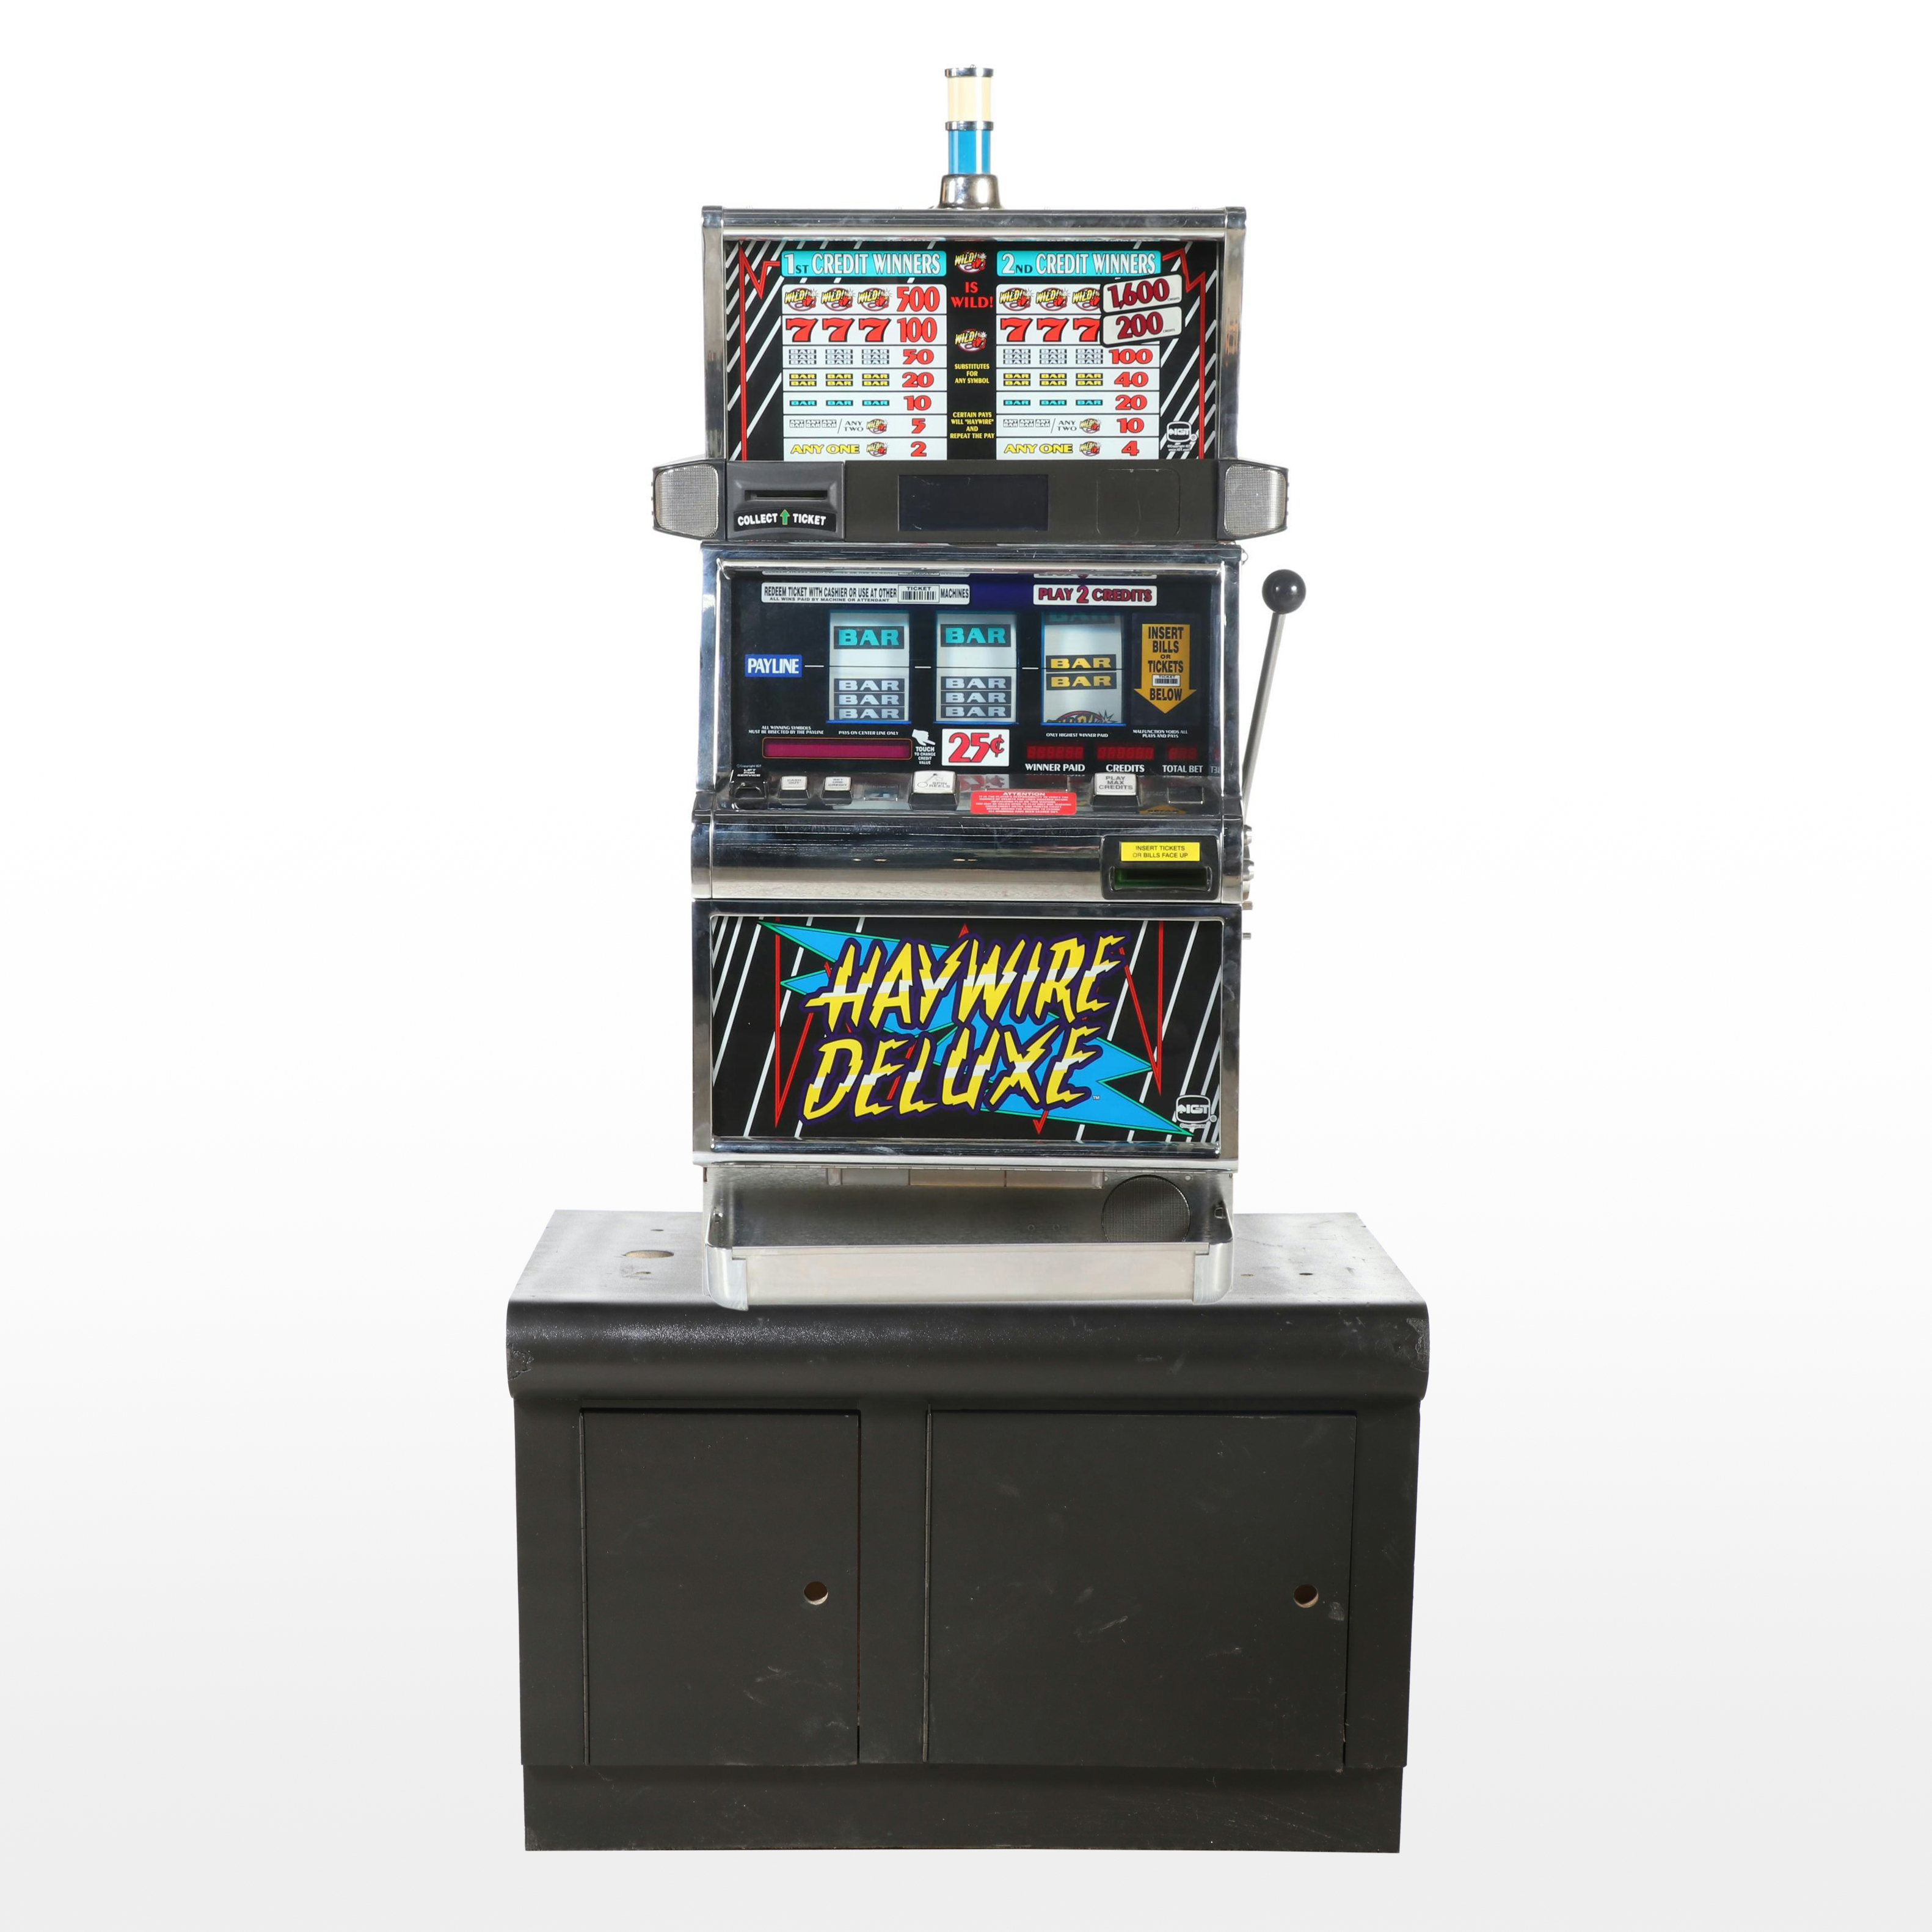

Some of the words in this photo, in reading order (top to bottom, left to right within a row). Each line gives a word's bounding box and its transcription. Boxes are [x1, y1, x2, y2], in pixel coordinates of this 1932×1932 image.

[784, 253, 809, 274] 1ST
[812, 253, 869, 274] CREDIT
[873, 253, 941, 274] WINNERS
[955, 252, 977, 266] WILD!
[1002, 253, 1033, 274] 2ND
[1036, 253, 1088, 274] CREDIT
[1093, 253, 1156, 274] WINNERS
[965, 282, 978, 293] IS
[999, 289, 1024, 303] WILD!
[1036, 289, 1060, 303] WILD!
[1107, 278, 1170, 308] 1,600
[785, 289, 809, 303] WILD!
[822, 289, 846, 303] WILD!
[858, 289, 883, 303] WILD!
[897, 286, 940, 312] 500
[950, 296, 994, 308] WILD!
[786, 318, 818, 342] 7
[822, 318, 855, 342] 7
[858, 318, 891, 342] 7
[897, 317, 938, 342] 100
[1000, 318, 1033, 342] 7
[1037, 318, 1070, 342] 7
[1073, 318, 1100, 342] 7
[1116, 312, 1164, 340] 200
[955, 331, 977, 344] WILD!
[903, 349, 935, 365] 50
[1109, 348, 1153, 364] 100
[902, 372, 934, 387] 20
[1114, 371, 1148, 387] 40
[903, 395, 931, 410] 10
[1115, 395, 1147, 410] 20
[911, 418, 926, 434] 5
[1117, 418, 1145, 433] 10
[790, 445, 823, 454] ANY
[826, 445, 860, 454] ONE
[911, 441, 927, 456] 2
[1004, 444, 1037, 453] ANY
[1040, 444, 1073, 453] ONE
[1121, 440, 1139, 456] 4
[737, 513, 778, 526] COLLECT
[793, 513, 826, 526] TICKET
[765, 587, 786, 597] REDEEM
[788, 587, 807, 597] TICKET
[809, 587, 823, 597] WITH
[824, 587, 847, 597] CASHIER
[848, 588, 856, 597] OR
[858, 588, 869, 597] USE
[870, 588, 877, 597] AT
[879, 588, 897, 598] OTHER
[941, 589, 969, 599] MACHINES
[1039, 588, 1074, 601] PLAY
[1076, 586, 1089, 603] 2
[1093, 589, 1152, 602] CREDITS
[839, 629, 899, 646] BAR
[945, 627, 1006, 644] BAR
[1148, 627, 1184, 640] INSERT
[1152, 641, 1179, 653] BILLS
[748, 658, 799, 674] PAYLINE
[1051, 657, 1112, 669] BAR
[1148, 661, 1184, 673] TICKETS
[839, 680, 899, 690] BAR
[946, 679, 1006, 688] BAR
[1051, 676, 1112, 687] BAR
[839, 694, 899, 705] BAR
[946, 693, 1006, 703] BAR
[1150, 688, 1182, 701] BELOW
[839, 709, 899, 719] BAR
[946, 707, 1006, 716] BAR
[949, 732, 1005, 763] 25¢
[1106, 764, 1145, 773] CREDITS
[804, 933, 1127, 1032] HAYWIRE
[803, 1025, 1102, 1120] DELUXE
[1186, 1104, 1209, 1114] IGT
